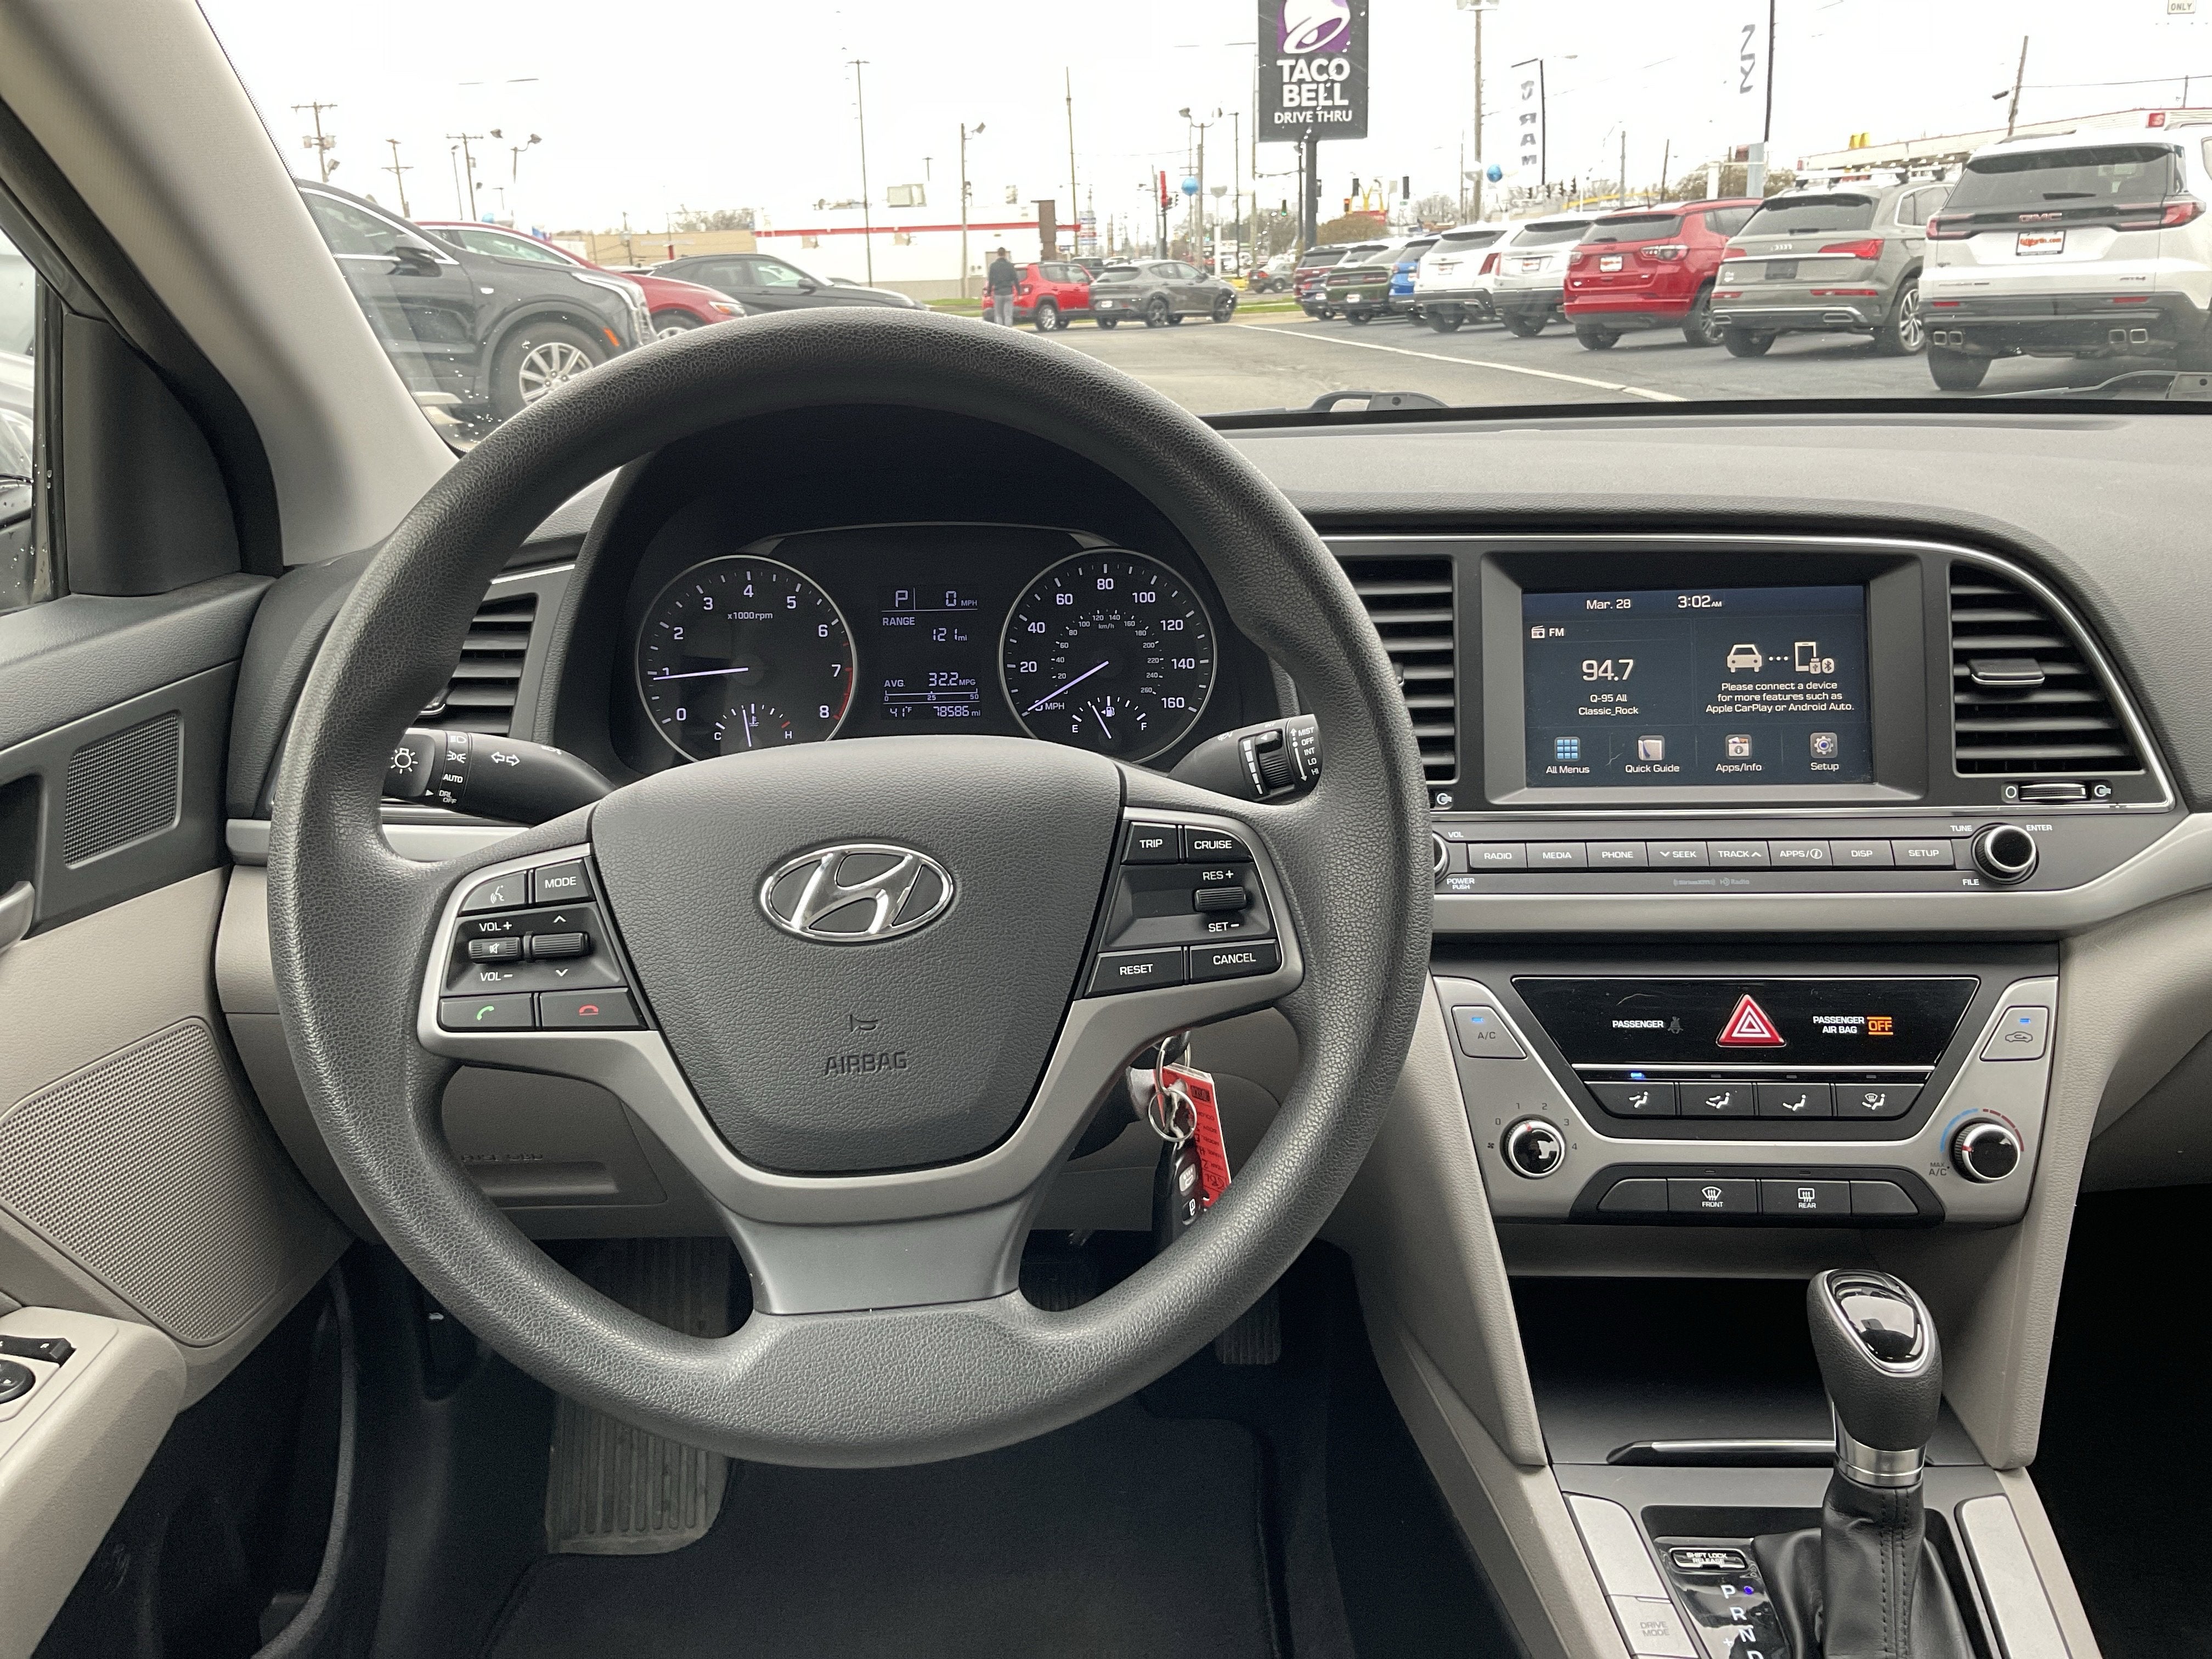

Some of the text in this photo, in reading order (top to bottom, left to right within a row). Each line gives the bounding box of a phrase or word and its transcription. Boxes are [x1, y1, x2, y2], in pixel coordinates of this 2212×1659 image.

[1276, 58, 1350, 82] TACO
[1283, 83, 1348, 107] BELL
[1274, 110, 1352, 123] DRIVE THRU
[2019, 213, 2062, 224] GMC
[1097, 578, 1114, 590] 80
[743, 584, 754, 597] 4
[786, 596, 796, 609] 5
[895, 590, 908, 607] P
[946, 591, 956, 606] 0
[1056, 594, 1073, 605] 60
[1132, 592, 1155, 603] 100
[703, 597, 713, 610] 3
[1587, 599, 1630, 609] Mar. 28
[883, 617, 915, 625] RANGE
[1160, 620, 1183, 630] 120
[818, 624, 828, 637] 6
[1028, 622, 1045, 633] 40
[1549, 628, 1564, 637] FM
[674, 628, 684, 640] 2
[1020, 662, 1037, 673] 20
[1171, 658, 1194, 669] 140
[831, 664, 841, 677] 7
[1582, 659, 1633, 681] 94.7
[1722, 683, 1753, 691] Please
[1161, 697, 1184, 708] 160
[1590, 695, 1613, 703] Q-95
[1718, 693, 1733, 702] for
[1763, 692, 1803, 701] features
[676, 708, 686, 720] 0
[820, 706, 829, 718] 8
[933, 706, 969, 717] 78586
[1578, 707, 1638, 716] Classic_Rock
[1706, 705, 1733, 714] Apple
[1735, 704, 1773, 713] CarPlay
[1788, 703, 1826, 711] Android
[1072, 725, 1078, 733] E
[1141, 723, 1147, 731] F
[1299, 727, 1314, 736] MIST
[714, 732, 721, 740] C
[1301, 737, 1313, 746] OFF
[1304, 747, 1315, 755] INT
[1625, 764, 1680, 773] Quick Guide
[1716, 763, 1762, 772] Apps/Info
[1810, 763, 1839, 771] Setup
[443, 774, 463, 783] AUTO
[1139, 839, 1163, 848] TRIP
[1194, 840, 1232, 849] CRUISE
[1851, 849, 1873, 857] DISP
[1908, 849, 1939, 857] SETUP
[545, 877, 577, 888] MODE
[1213, 953, 1256, 964] CANCEL
[1119, 964, 1153, 975] RESET
[1612, 1020, 1663, 1029] PASSENGER
[1813, 1016, 1864, 1025] PASSENGER
[1868, 1019, 1892, 1031] OFF
[1477, 1031, 1496, 1040] A/C
[1839, 1026, 1857, 1034] BAG
[825, 1051, 907, 1076] AIRBAG
[1929, 1167, 1947, 1176] A/C
[1720, 1585, 1735, 1599] P
[1730, 1607, 1747, 1620] R
[1739, 1628, 1756, 1642] N
